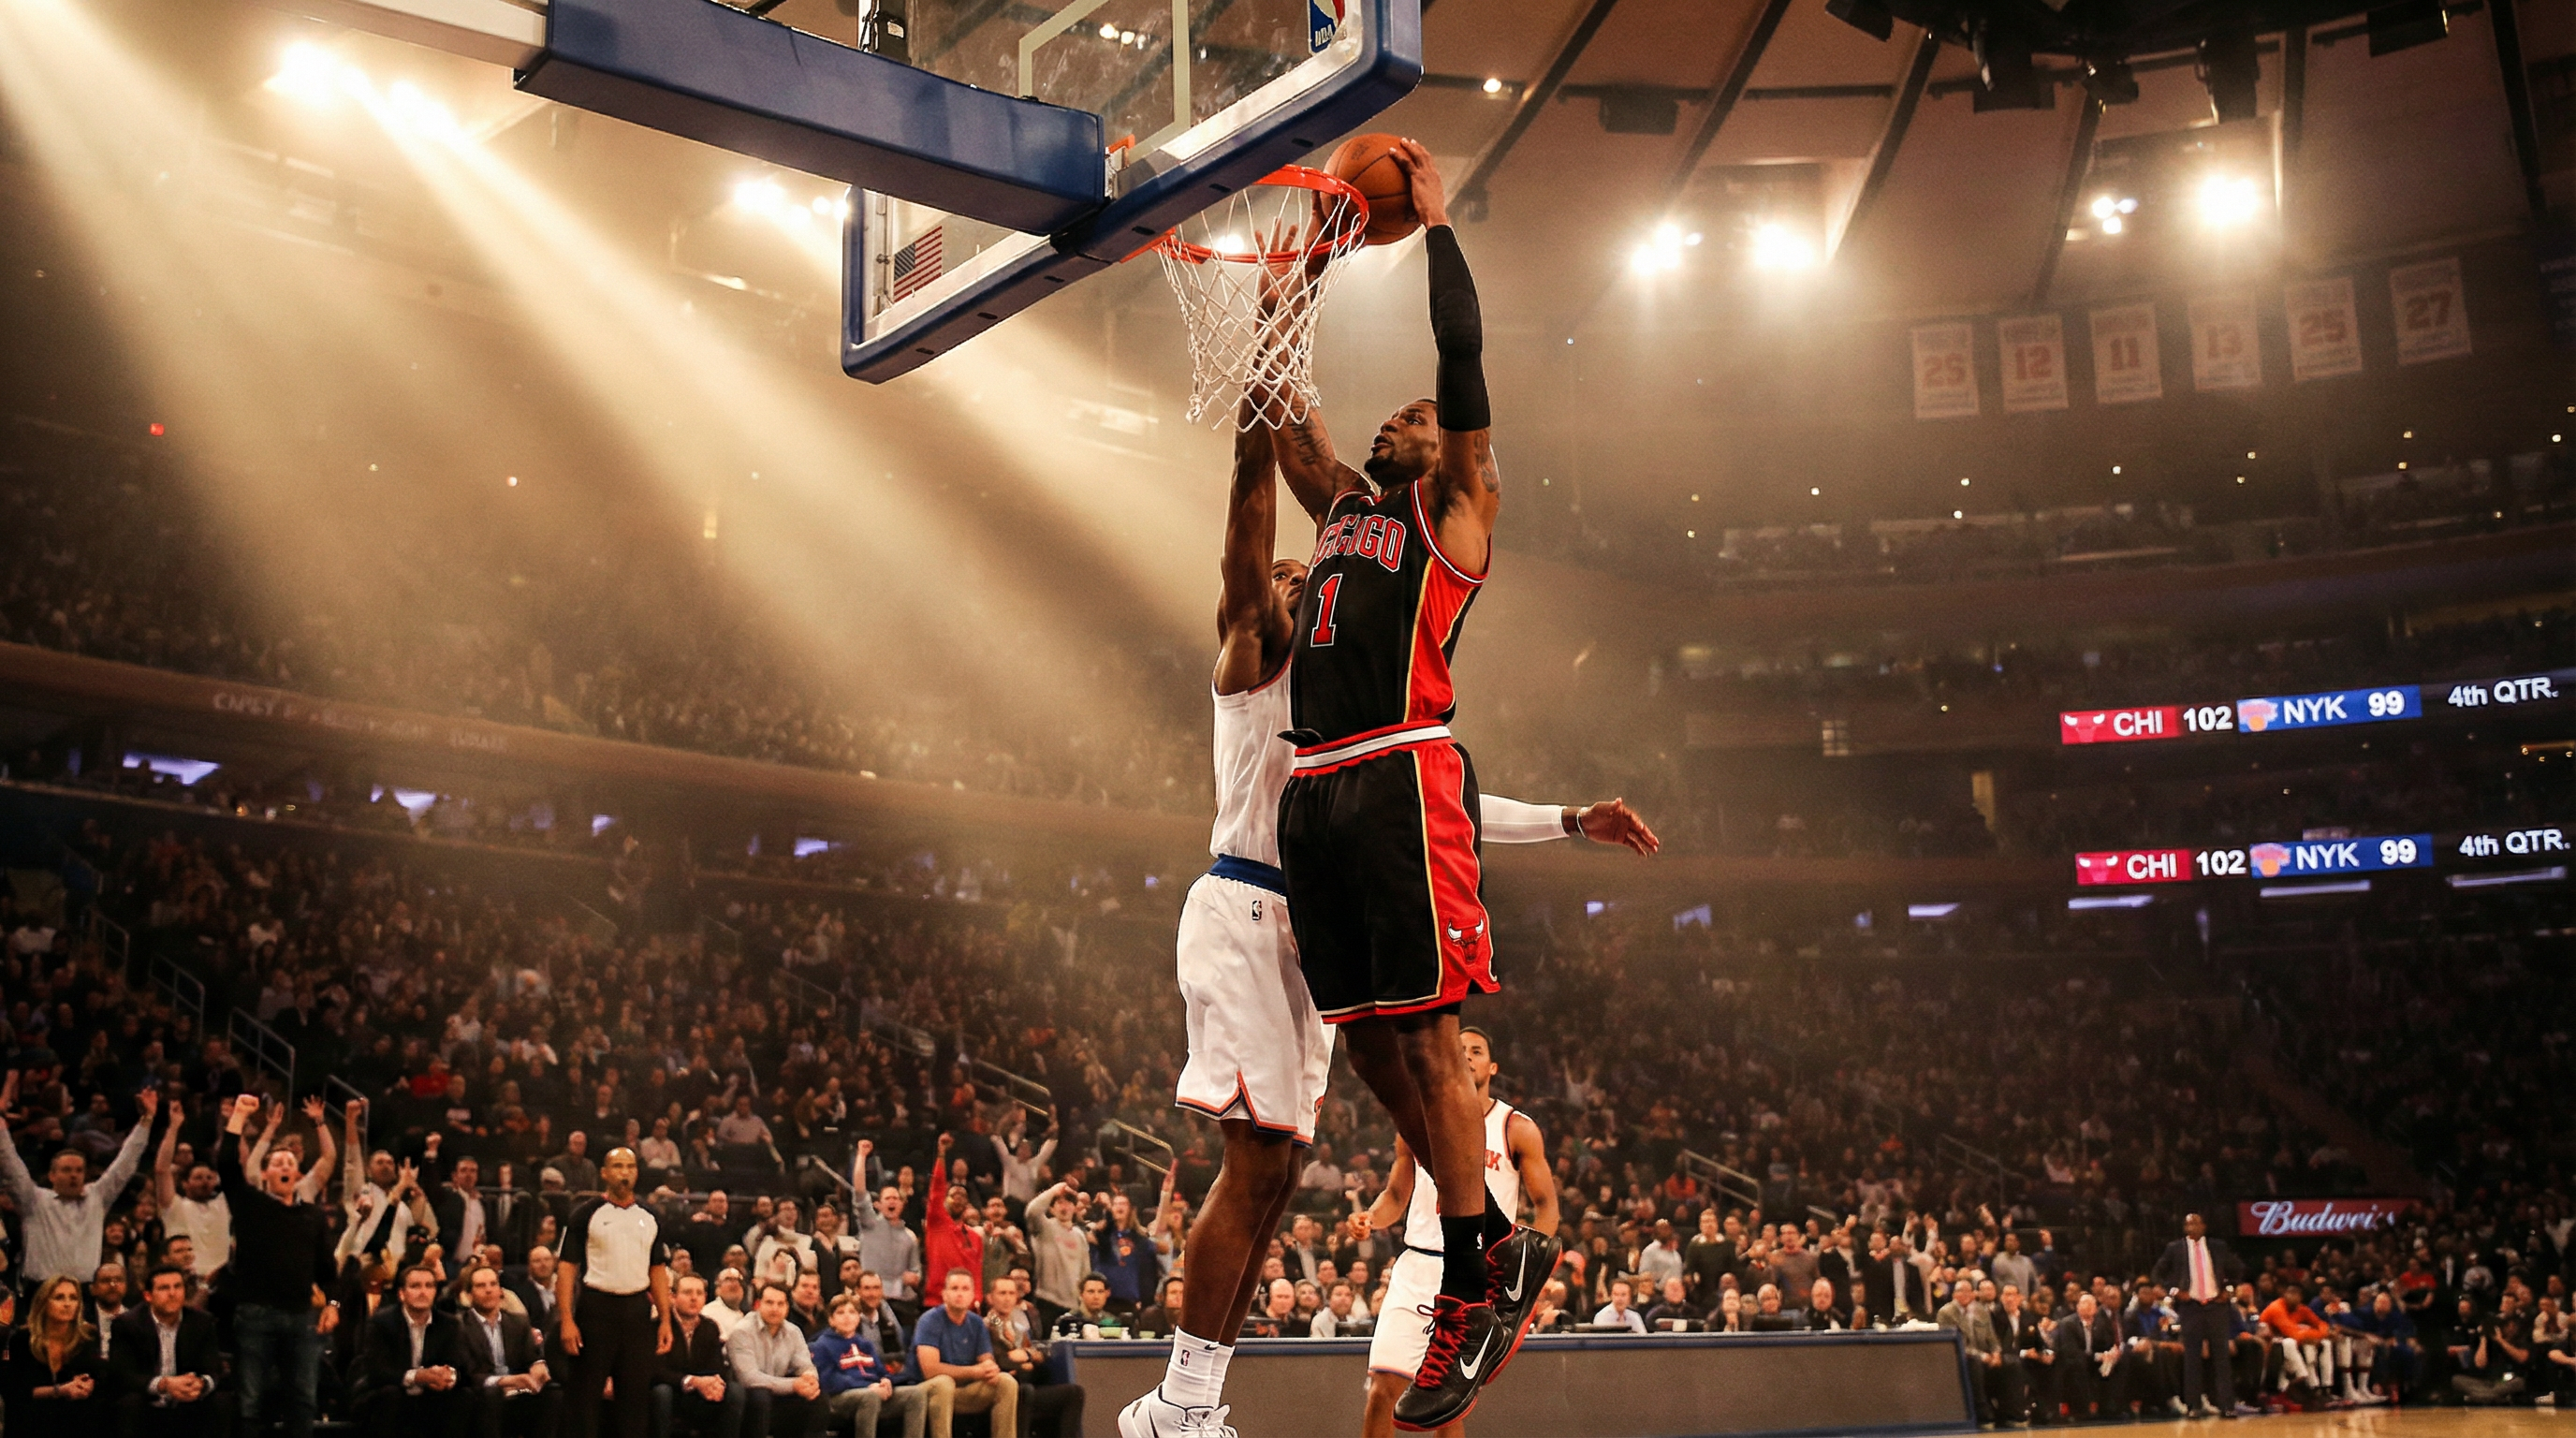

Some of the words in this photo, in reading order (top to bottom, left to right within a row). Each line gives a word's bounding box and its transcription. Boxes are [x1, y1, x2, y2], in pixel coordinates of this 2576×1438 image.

[2299, 309, 2349, 347] 25
[2406, 288, 2453, 330] 27
[2013, 345, 2053, 381] 12
[2109, 336, 2142, 372] 11
[1310, 573, 1344, 648] 1
[2113, 709, 2163, 737] CHI
[2183, 705, 2233, 732] 102
[2283, 694, 2348, 725] NYK
[2367, 689, 2406, 717] 99
[2447, 683, 2488, 709] 4th
[2493, 676, 2559, 704] QTR.
[2126, 852, 2177, 880] CHI
[2195, 849, 2247, 876] 102
[2296, 841, 2360, 871] NYK
[2379, 837, 2417, 866] 99
[2458, 834, 2500, 858] 4th
[2505, 829, 2571, 856] QTR.
